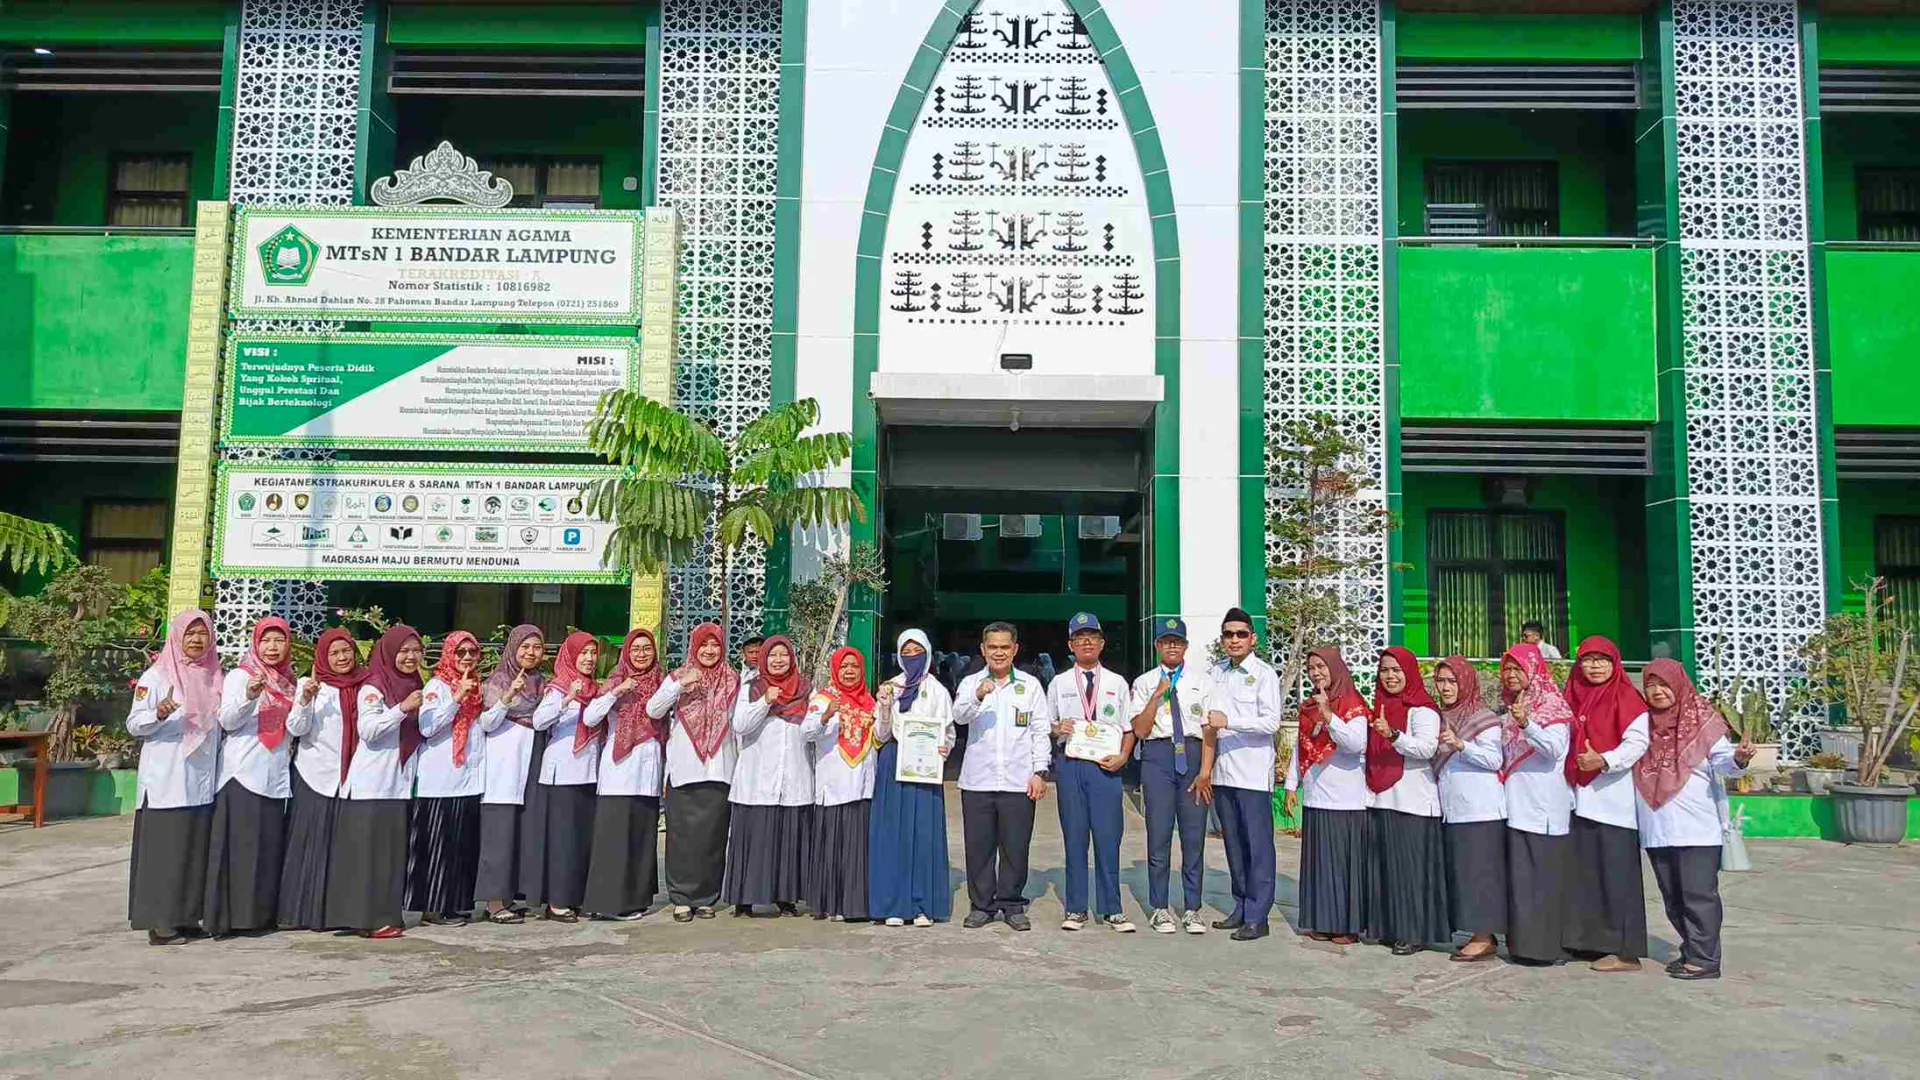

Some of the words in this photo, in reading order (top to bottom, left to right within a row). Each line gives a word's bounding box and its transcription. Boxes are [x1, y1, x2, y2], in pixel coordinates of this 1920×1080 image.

[371, 227, 502, 242] KEMENTERIAN
[506, 229, 572, 242] AGAMA
[326, 245, 387, 262] MTsN
[395, 246, 402, 262] 1
[410, 246, 500, 263] BANDAR
[506, 248, 616, 264] LAMPUNG
[397, 268, 520, 280] TERAKREDITASI
[388, 280, 431, 291] Nomor
[433, 281, 483, 292] Statistik
[497, 282, 550, 292] 10816982
[284, 296, 318, 304] Ahmad
[434, 298, 468, 306] Bandar
[471, 299, 516, 308] Lampung
[517, 299, 554, 309] Telepon
[243, 347, 270, 357] VISI
[577, 356, 606, 366] MISI
[241, 362, 305, 372] Terwujudnya
[308, 363, 344, 372] Peserta
[347, 364, 376, 372] Didik
[240, 374, 264, 384] Yang
[266, 374, 299, 383] Kokoh
[240, 386, 274, 396] Unggul
[277, 386, 317, 395] Prestasi
[320, 387, 340, 395] Dan
[238, 397, 265, 408] Bijak
[268, 398, 332, 408] Berteknologi
[408, 480, 416, 488] &
[418, 480, 460, 489] SARANA
[466, 480, 492, 490] MTsN
[504, 481, 545, 490] BANDAR
[568, 531, 578, 542] P
[322, 555, 378, 564] MADRASAH
[382, 556, 410, 565] MAJU
[414, 556, 462, 566] BERMUTU
[466, 557, 520, 566] MENDUNIA
